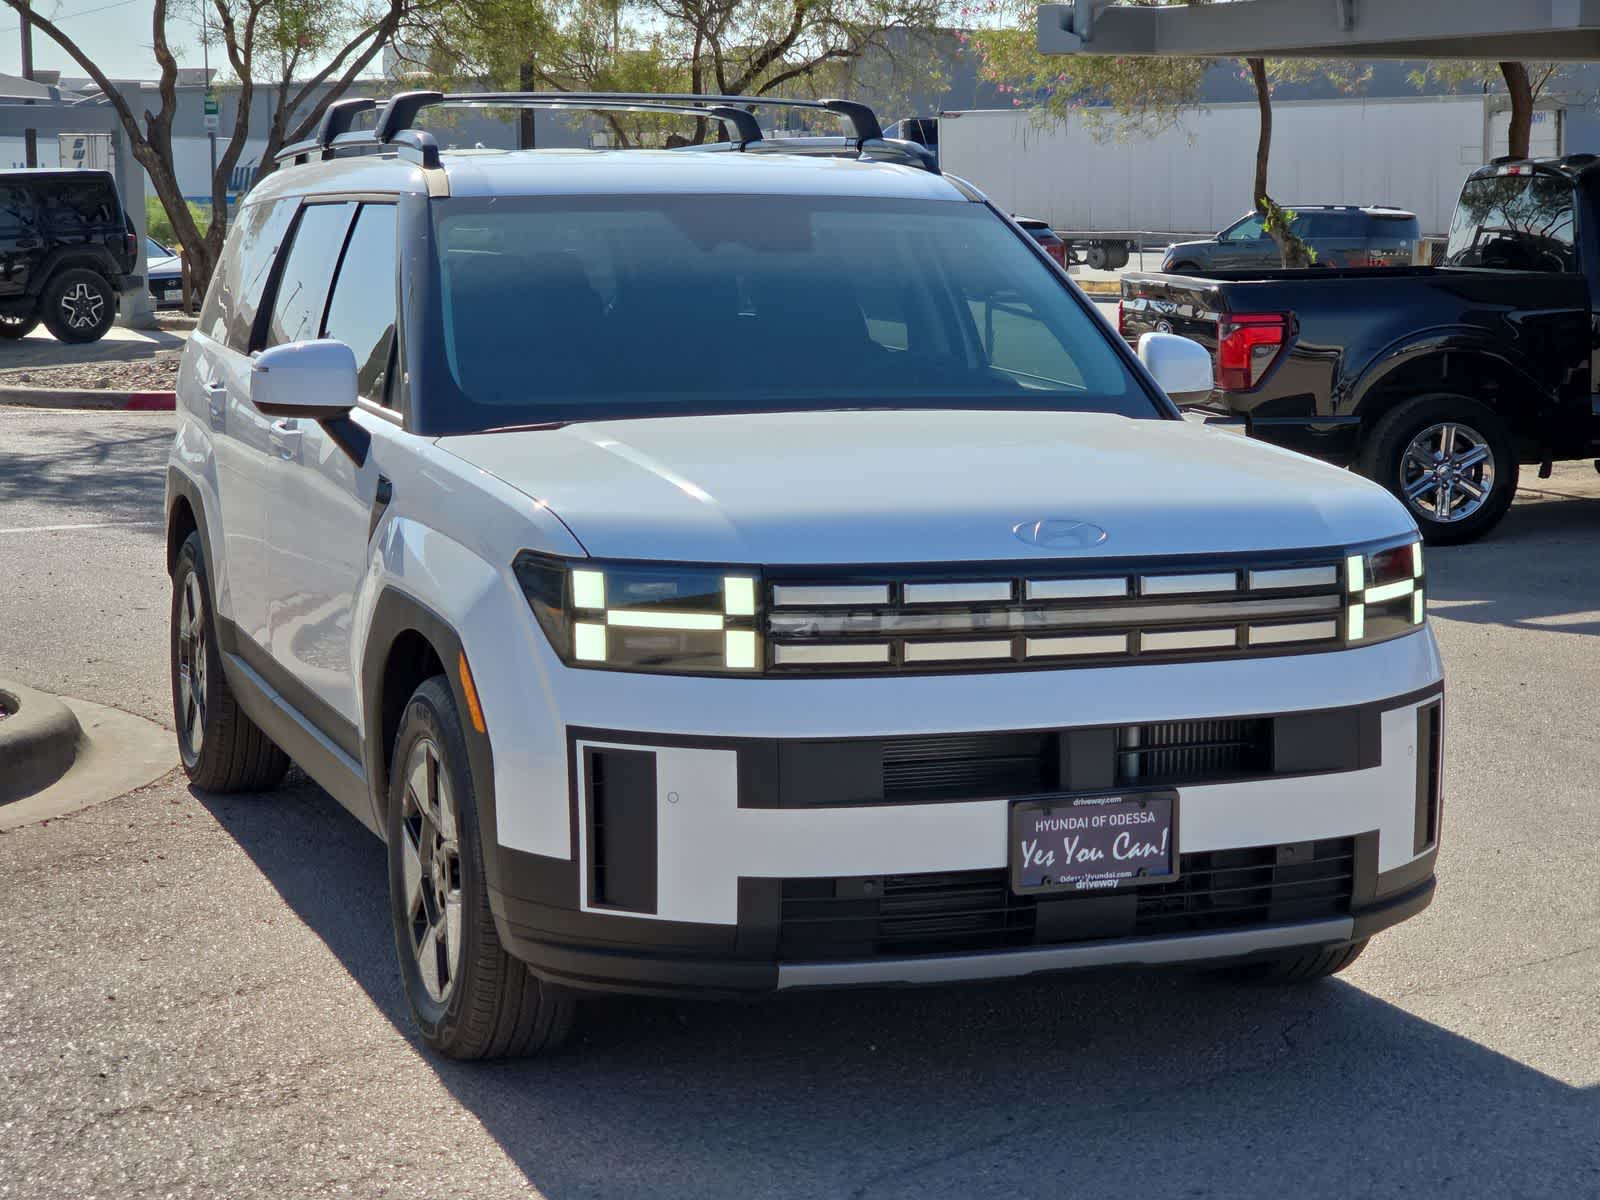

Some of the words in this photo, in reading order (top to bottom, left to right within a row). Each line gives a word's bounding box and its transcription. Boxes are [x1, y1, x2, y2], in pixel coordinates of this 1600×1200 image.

[1073, 797, 1122, 807] driveway.com
[1035, 817, 1088, 832] HYUNDAI
[1092, 815, 1107, 828] OF
[1109, 812, 1156, 827] ODESSA
[1021, 839, 1056, 868] Yes
[1063, 835, 1104, 865] You
[1112, 827, 1169, 861] Can!
[1075, 878, 1119, 890] driveway
